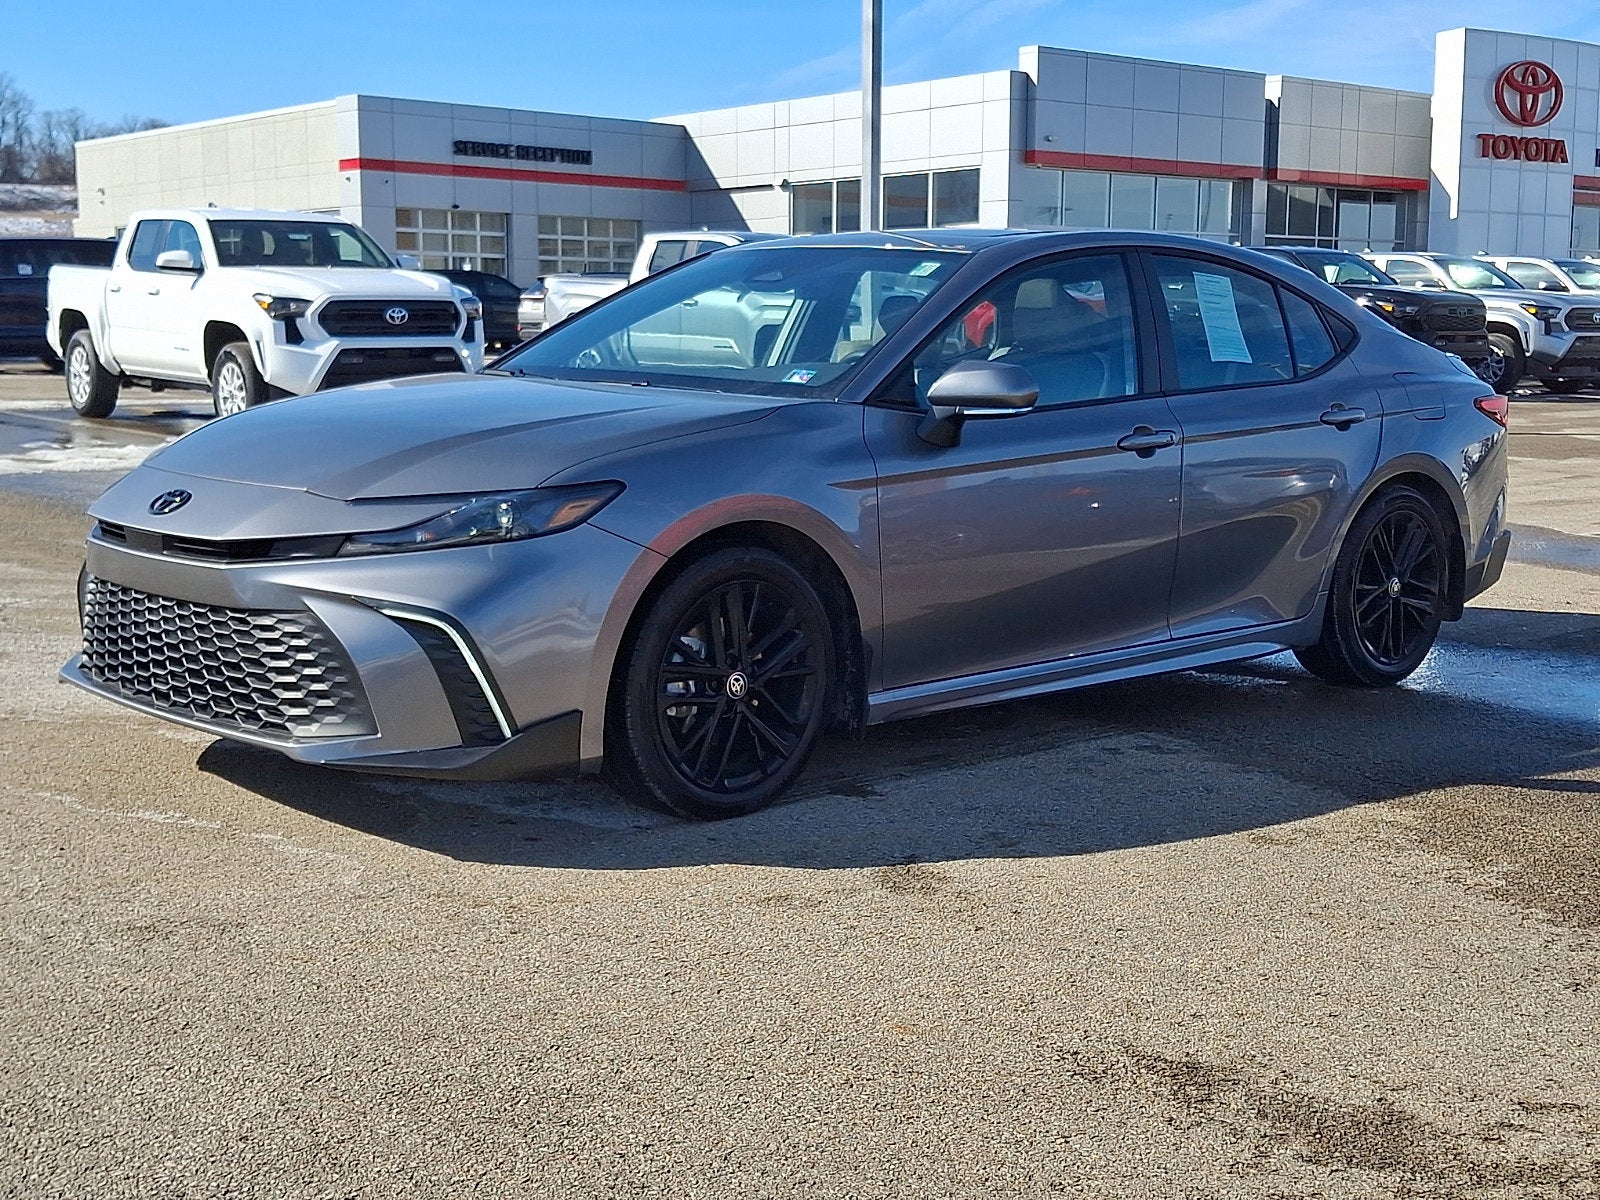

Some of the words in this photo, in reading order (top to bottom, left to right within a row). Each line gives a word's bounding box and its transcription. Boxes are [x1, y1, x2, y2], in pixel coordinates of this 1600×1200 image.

[453, 140, 515, 159] SERVICE
[516, 145, 592, 165] RECEPTION
[1477, 133, 1569, 164] TOYOTA
